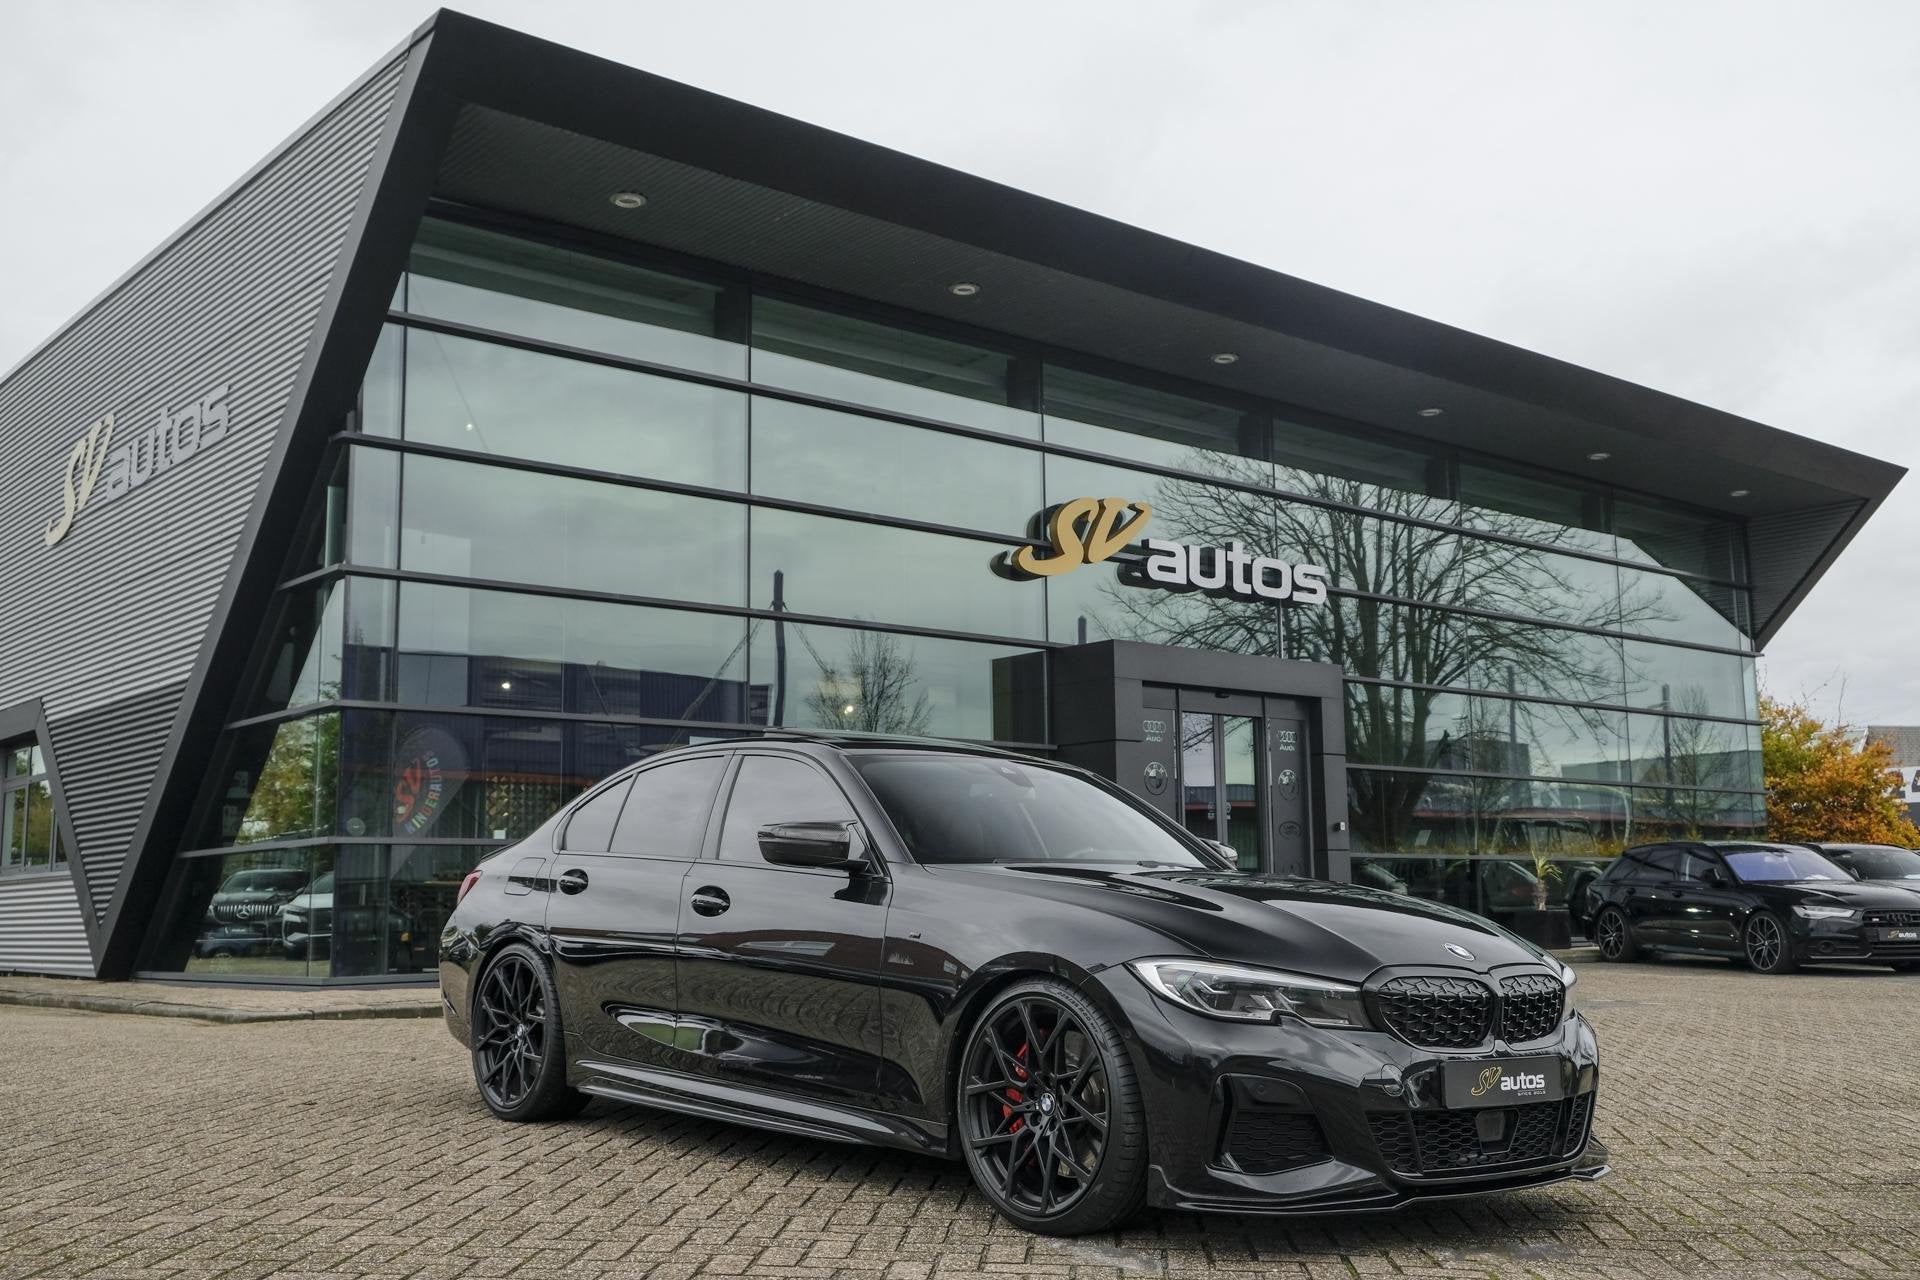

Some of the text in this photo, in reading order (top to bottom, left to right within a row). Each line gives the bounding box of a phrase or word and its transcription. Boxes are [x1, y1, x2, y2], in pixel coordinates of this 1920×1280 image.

[106, 383, 229, 502] autos
[1016, 496, 1328, 605] SV autos
[1500, 1072, 1545, 1091] autos
